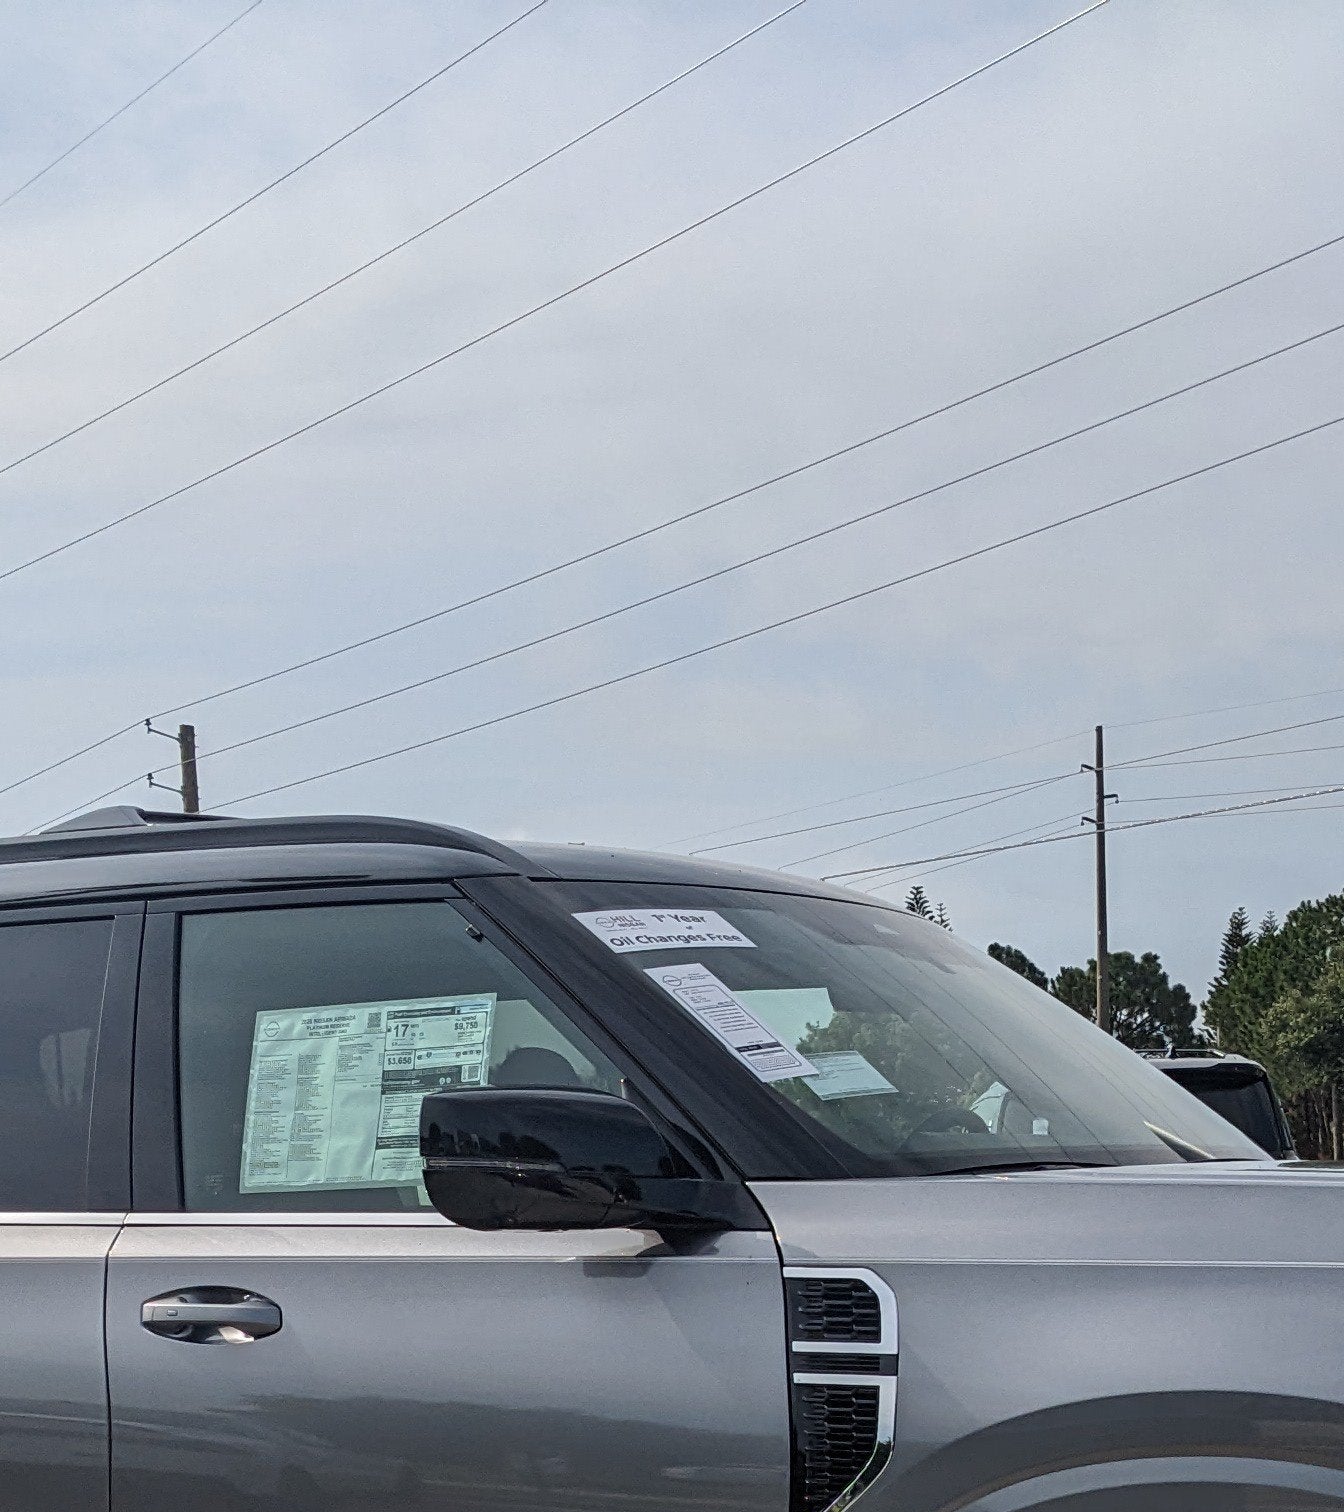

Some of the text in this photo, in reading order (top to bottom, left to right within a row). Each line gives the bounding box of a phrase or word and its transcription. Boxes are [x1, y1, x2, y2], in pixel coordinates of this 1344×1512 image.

[667, 913, 707, 923] Year
[609, 933, 743, 947] Oil Changes Free
[393, 1024, 409, 1038] 17
